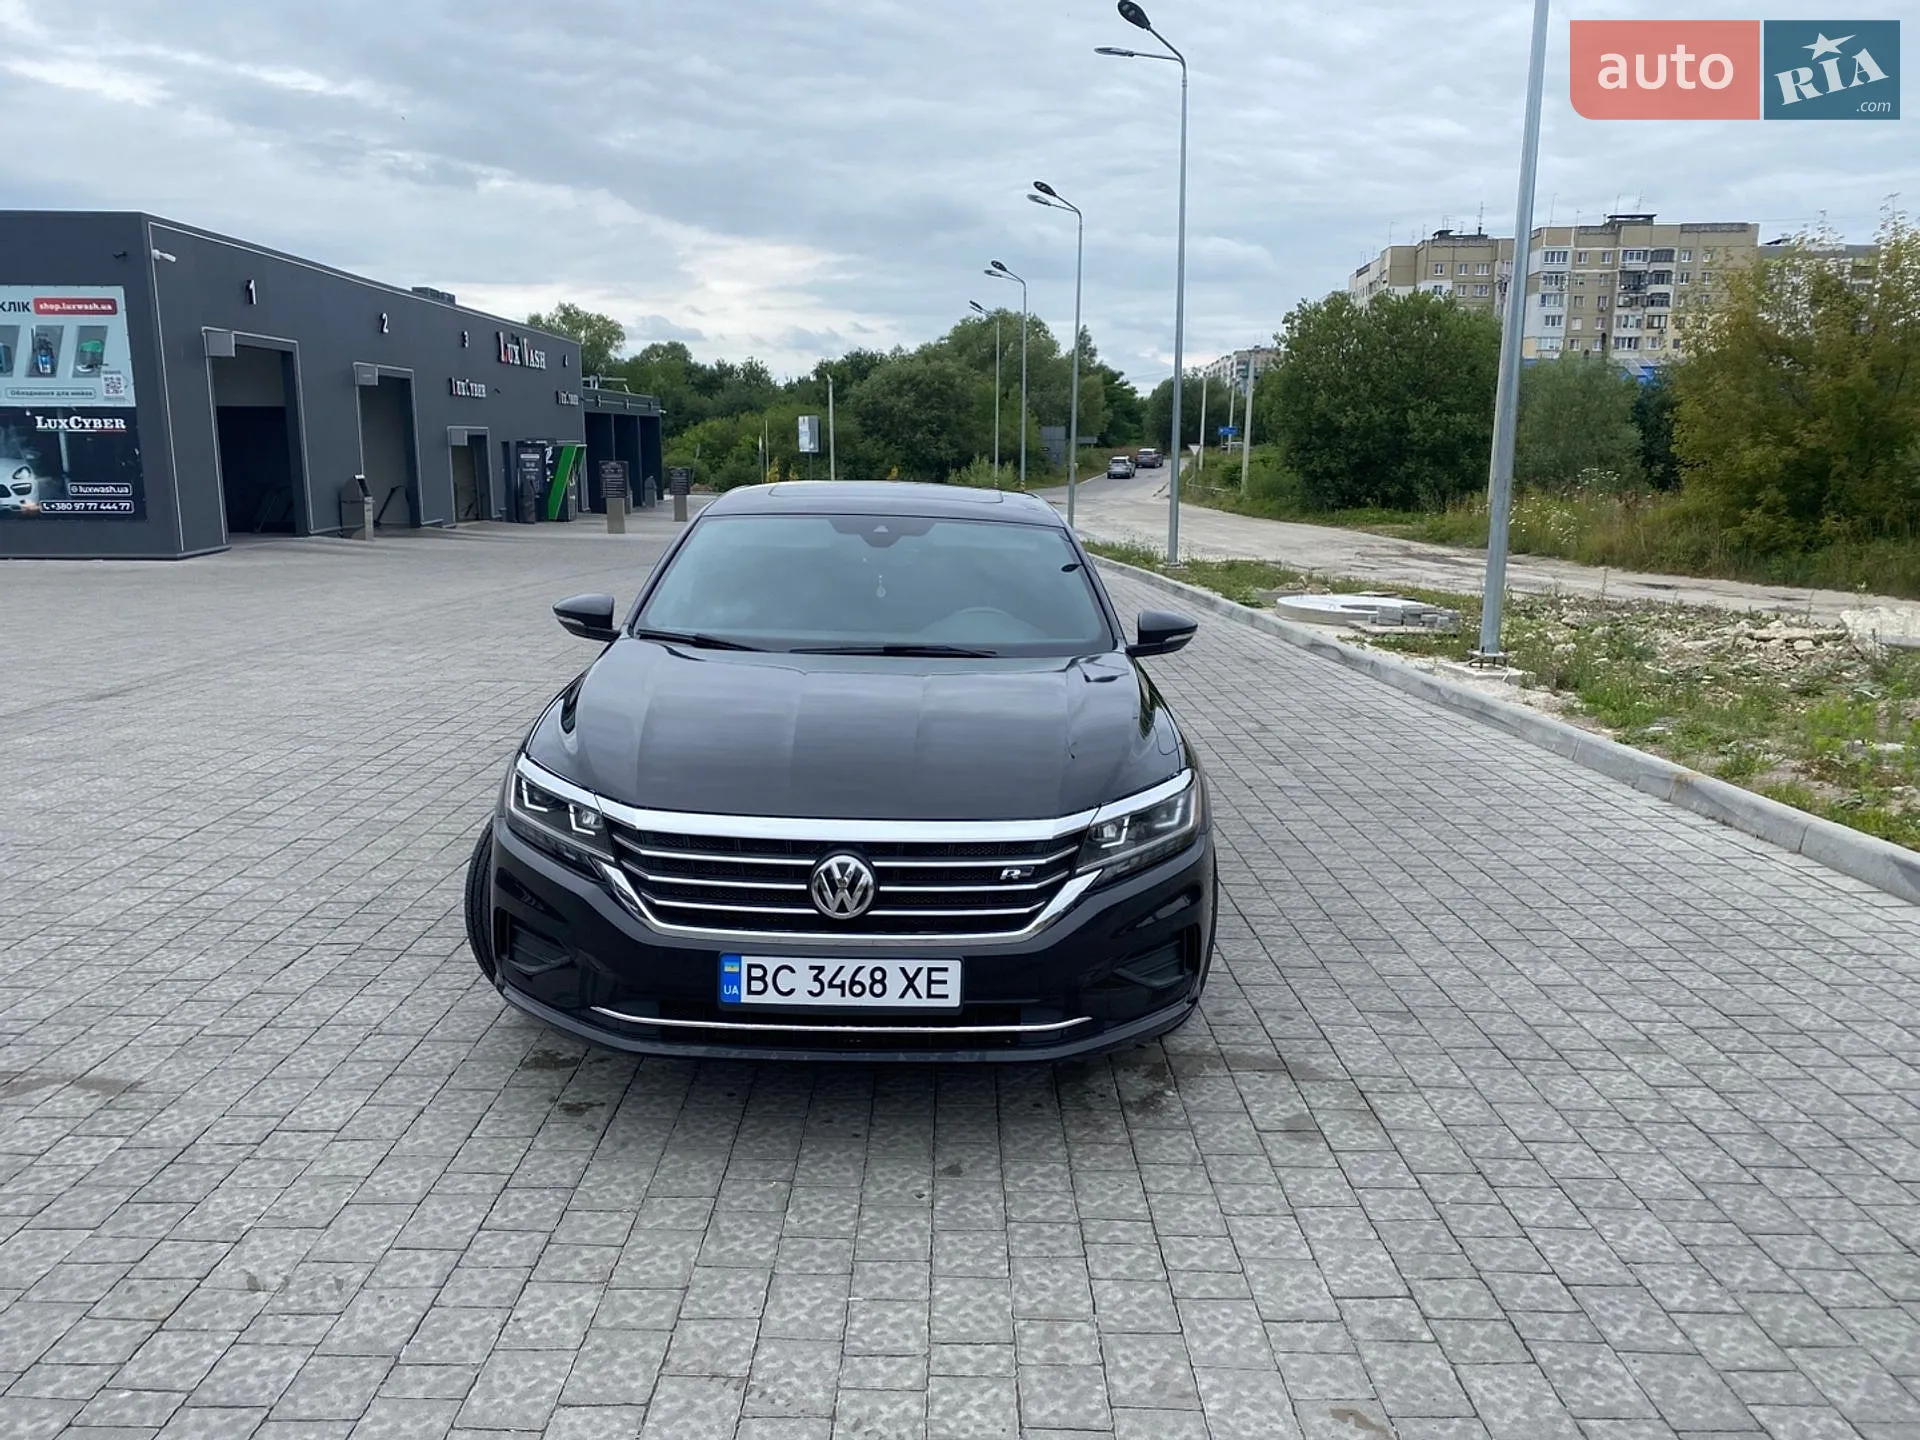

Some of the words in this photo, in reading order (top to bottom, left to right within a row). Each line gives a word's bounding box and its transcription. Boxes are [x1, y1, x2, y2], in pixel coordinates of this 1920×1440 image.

[248, 279, 257, 305] 1
[381, 312, 389, 334] 2
[724, 985, 739, 995] UA
[746, 963, 796, 996] BC
[807, 965, 887, 999] 3468
[899, 966, 949, 999] XE
